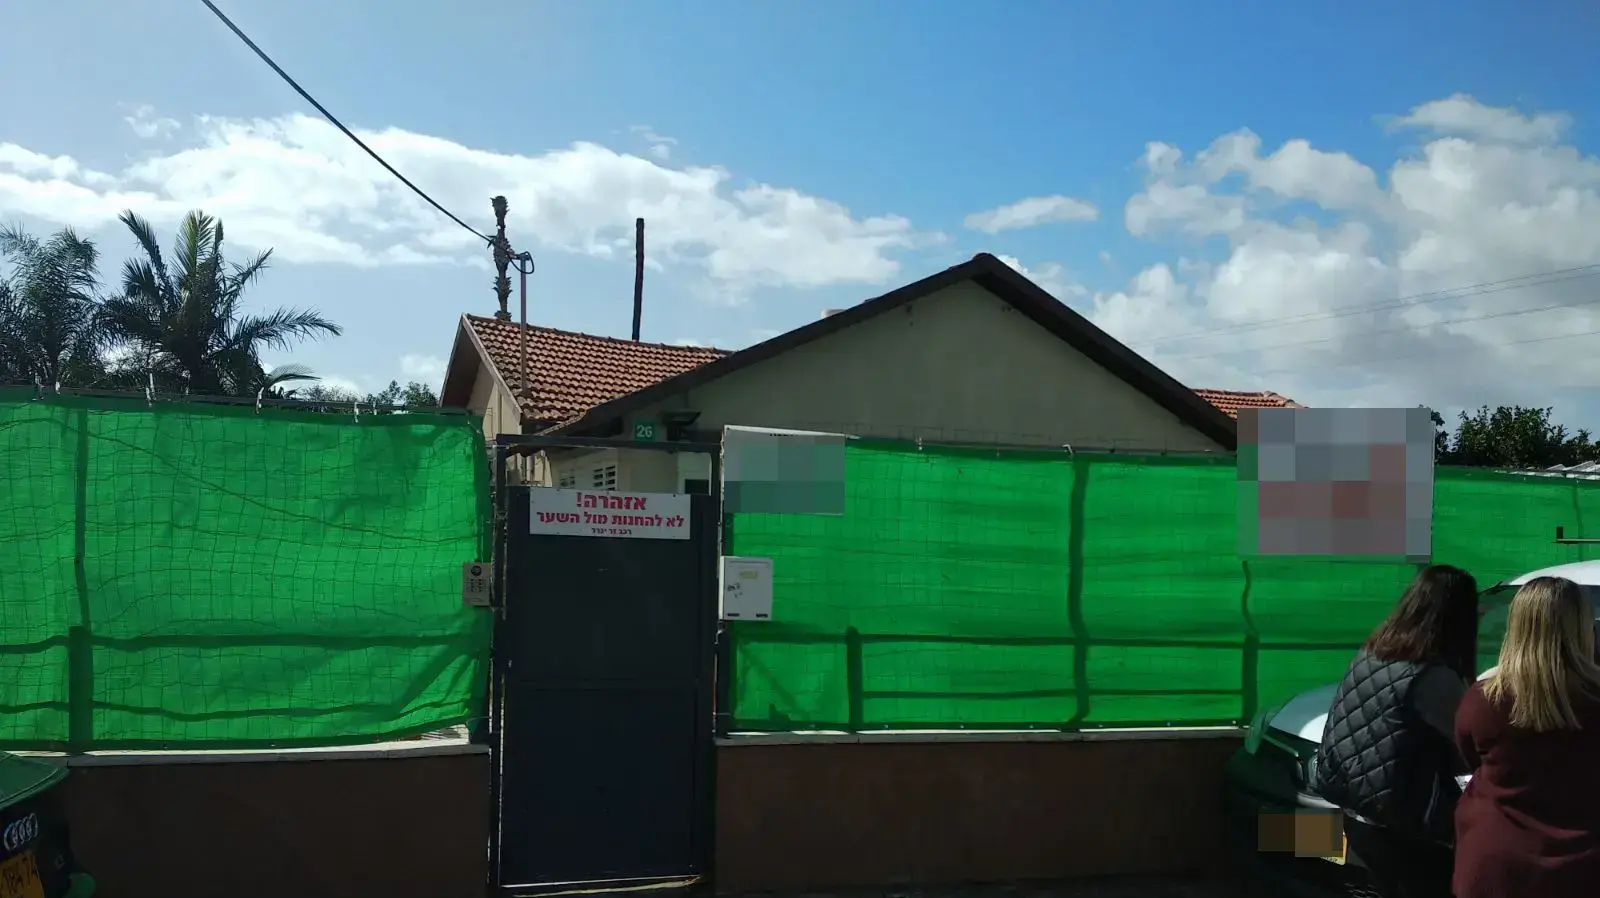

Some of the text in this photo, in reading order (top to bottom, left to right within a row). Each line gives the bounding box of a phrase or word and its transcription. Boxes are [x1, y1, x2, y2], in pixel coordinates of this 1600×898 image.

[636, 424, 653, 438] 26
[576, 492, 647, 511] אזהרה!
[536, 511, 685, 528] לא להחנות מול השער
[618, 528, 632, 536] רכב
